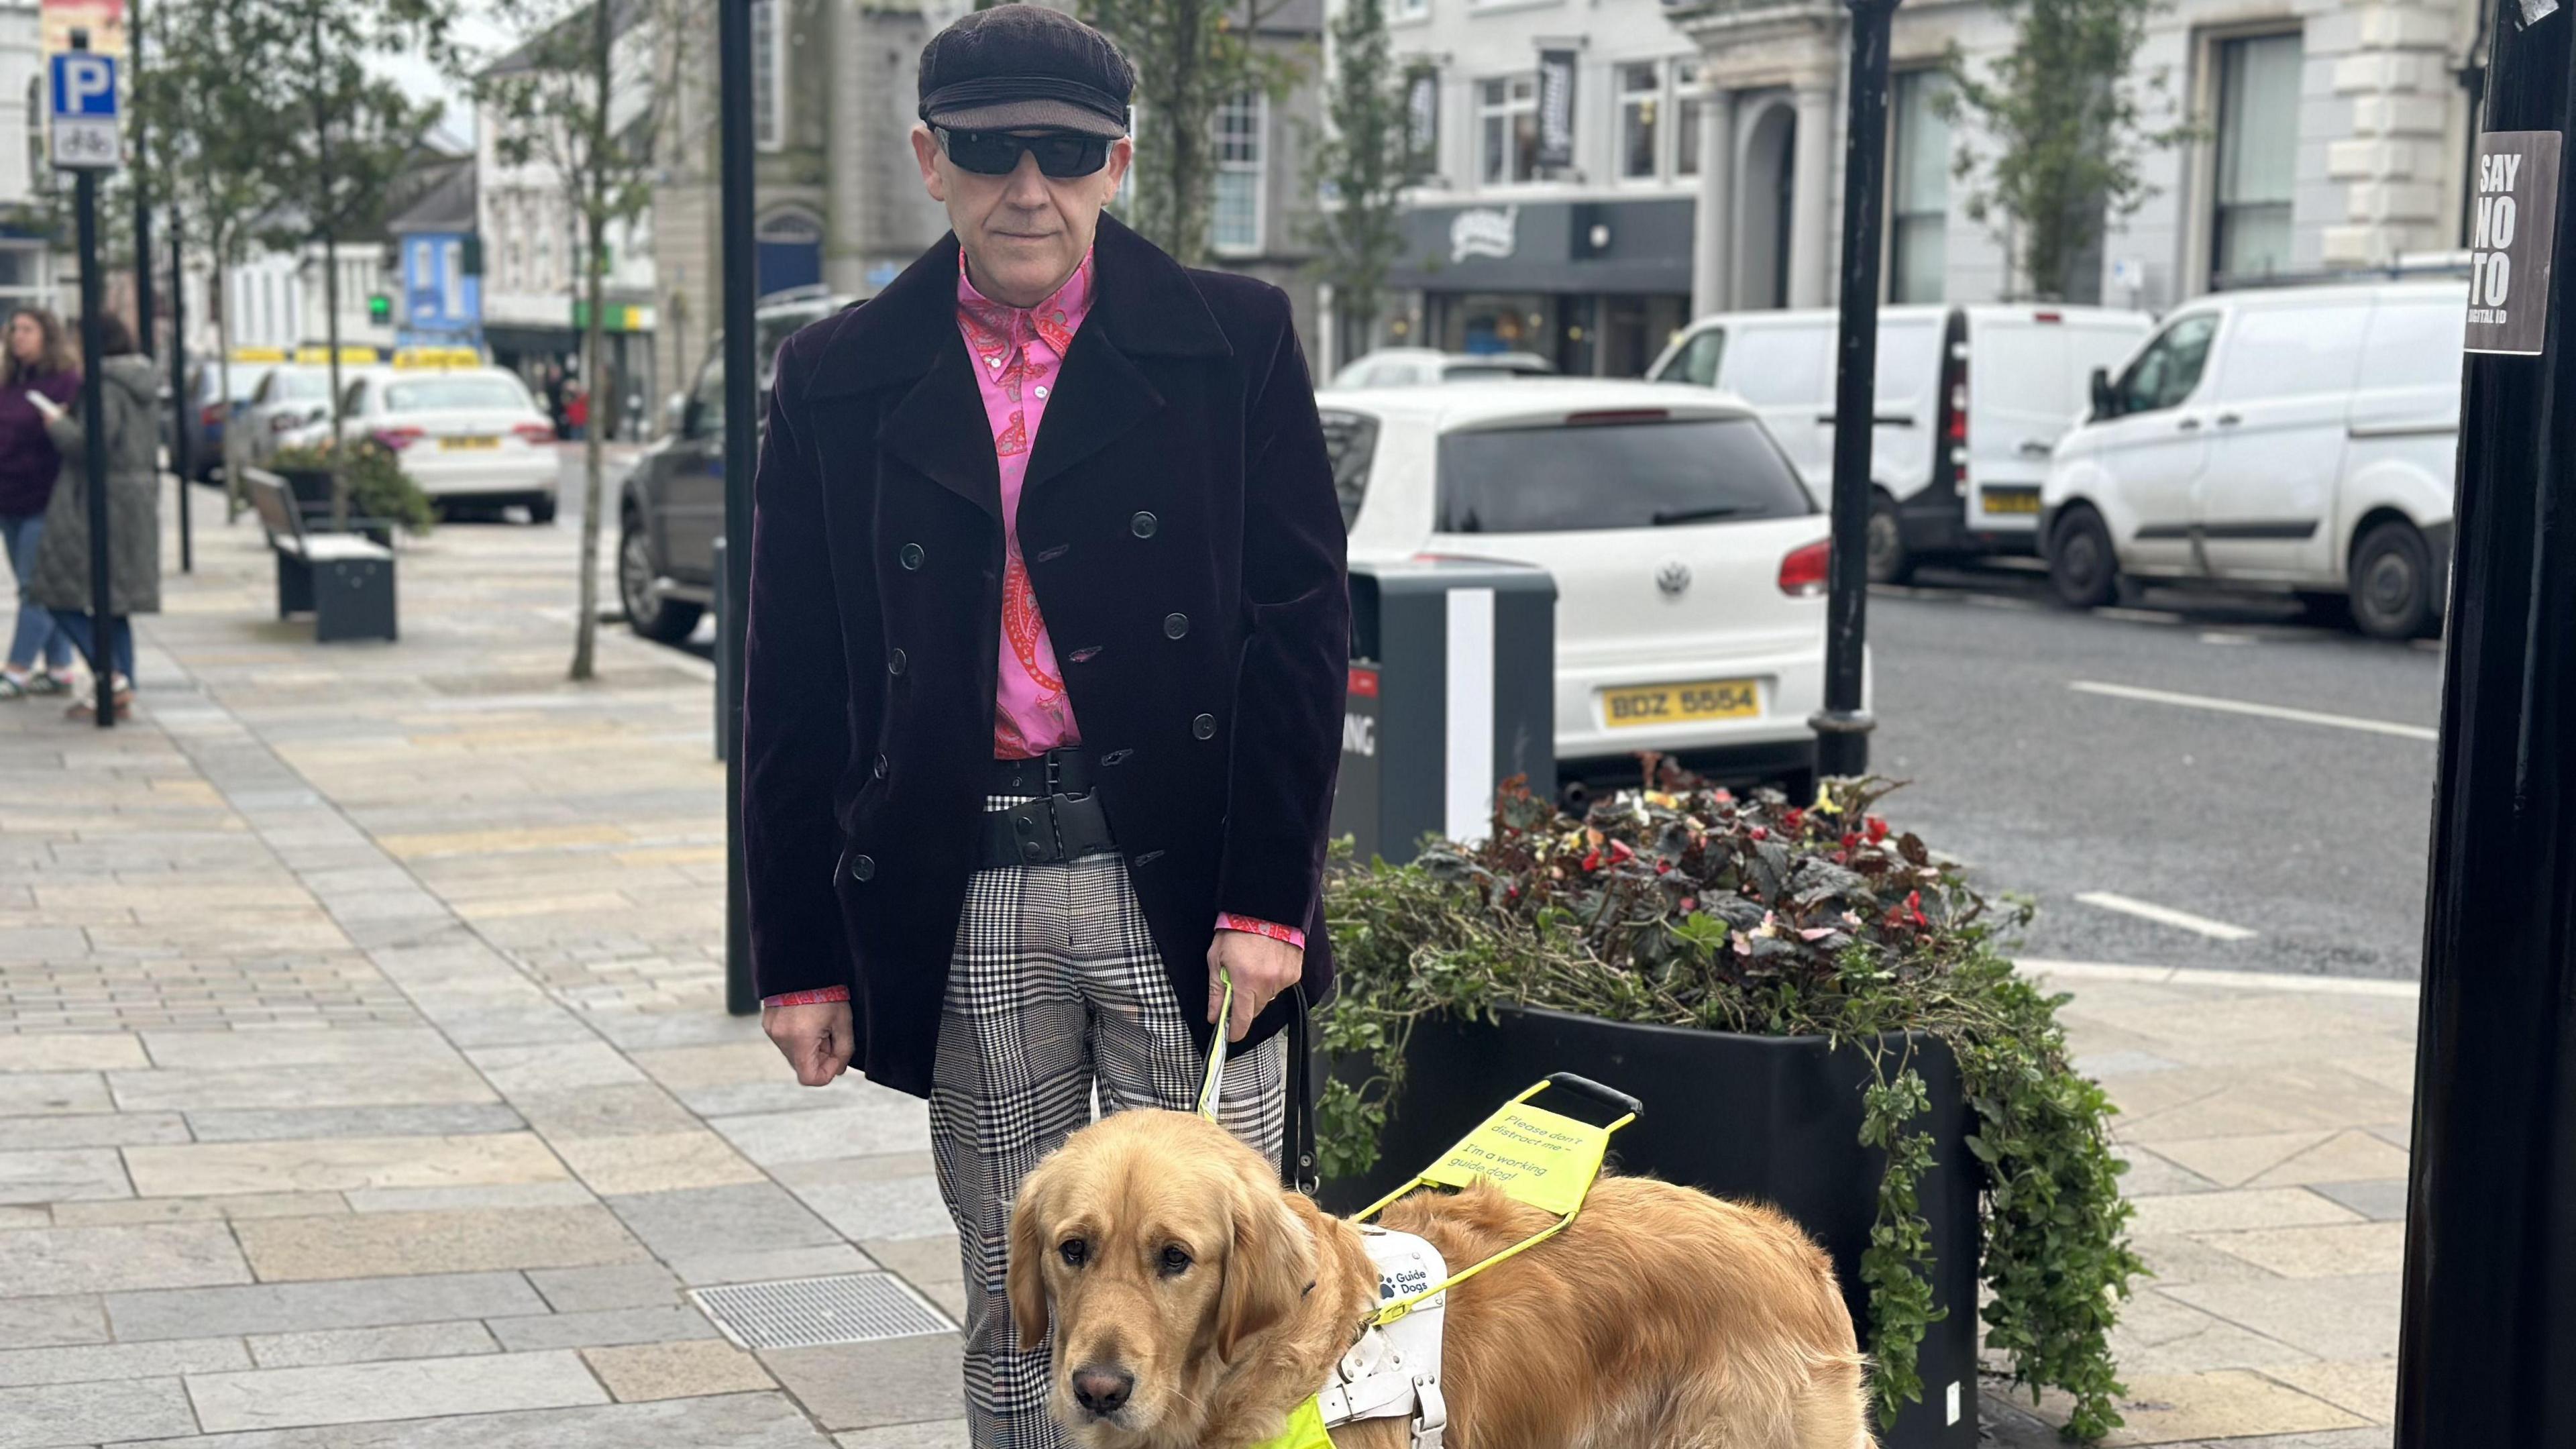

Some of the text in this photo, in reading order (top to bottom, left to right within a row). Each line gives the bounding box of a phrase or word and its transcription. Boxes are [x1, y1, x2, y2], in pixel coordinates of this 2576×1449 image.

[65, 60, 109, 113] P
[2480, 154, 2522, 193] SAY
[2475, 196, 2516, 249] NO
[2471, 252, 2510, 307] TO
[2496, 309, 2507, 324] ID
[1613, 688, 1753, 718] BDZ 5554
[1491, 1124, 1542, 1146] distract
[1542, 1142, 1562, 1152] me
[1505, 1115, 1583, 1145] Please don't
[1447, 1158, 1518, 1181] guide dog!
[1462, 1144, 1547, 1177] I'm a working
[1396, 1269, 1426, 1282] Guide
[1400, 1282, 1428, 1294] Dogs
